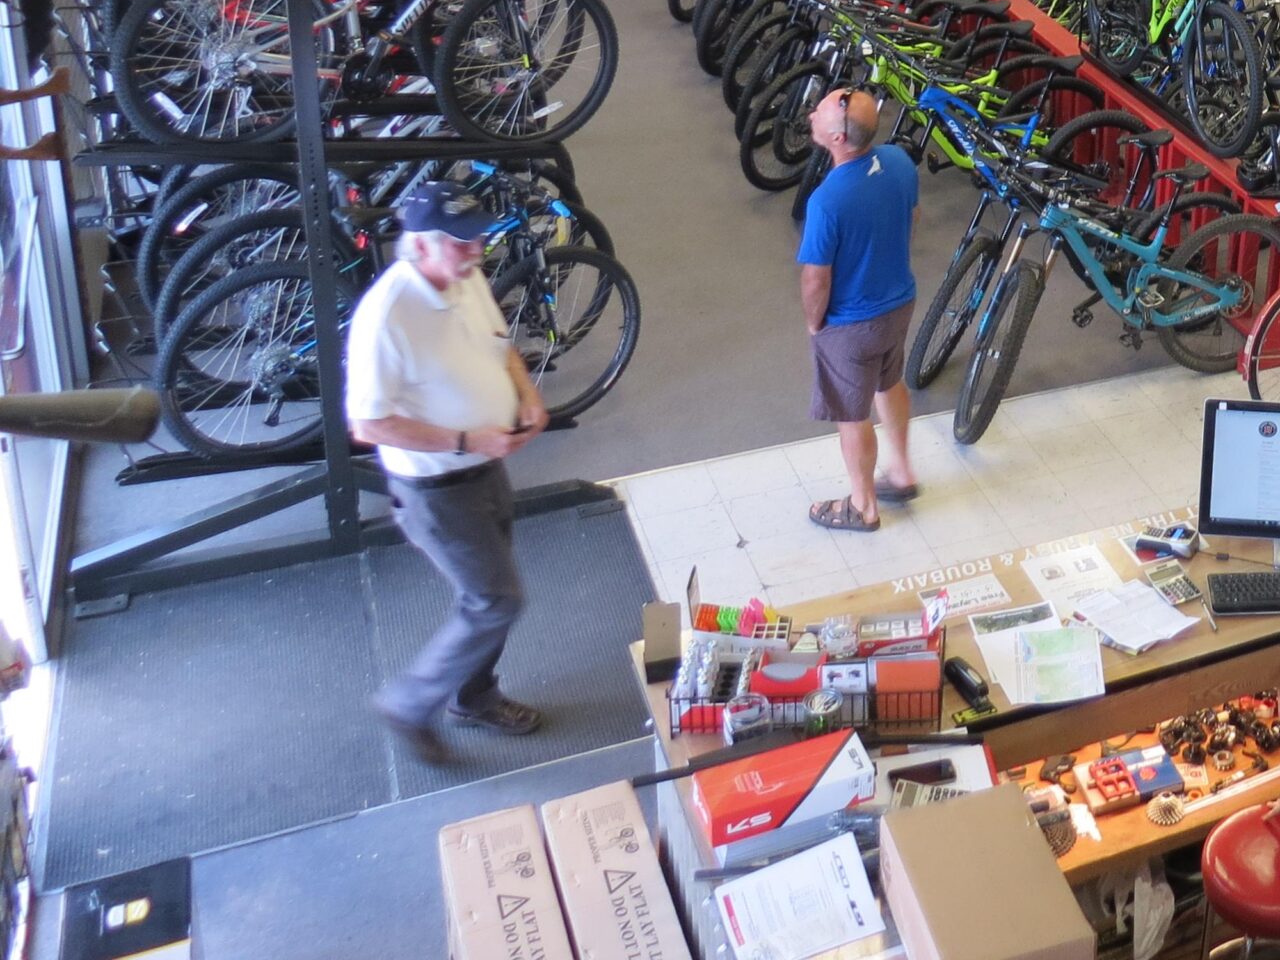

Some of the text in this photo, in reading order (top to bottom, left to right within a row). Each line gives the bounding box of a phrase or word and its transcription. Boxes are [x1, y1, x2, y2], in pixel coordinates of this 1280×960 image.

[999, 552, 1014, 566] &
[890, 557, 993, 595] ROUBAIX
[726, 811, 772, 835] KS
[611, 896, 628, 917] DO
[628, 883, 649, 918] FLAT
[503, 923, 519, 944] DO
[521, 909, 541, 944] FLAT
[617, 918, 639, 950] NOT
